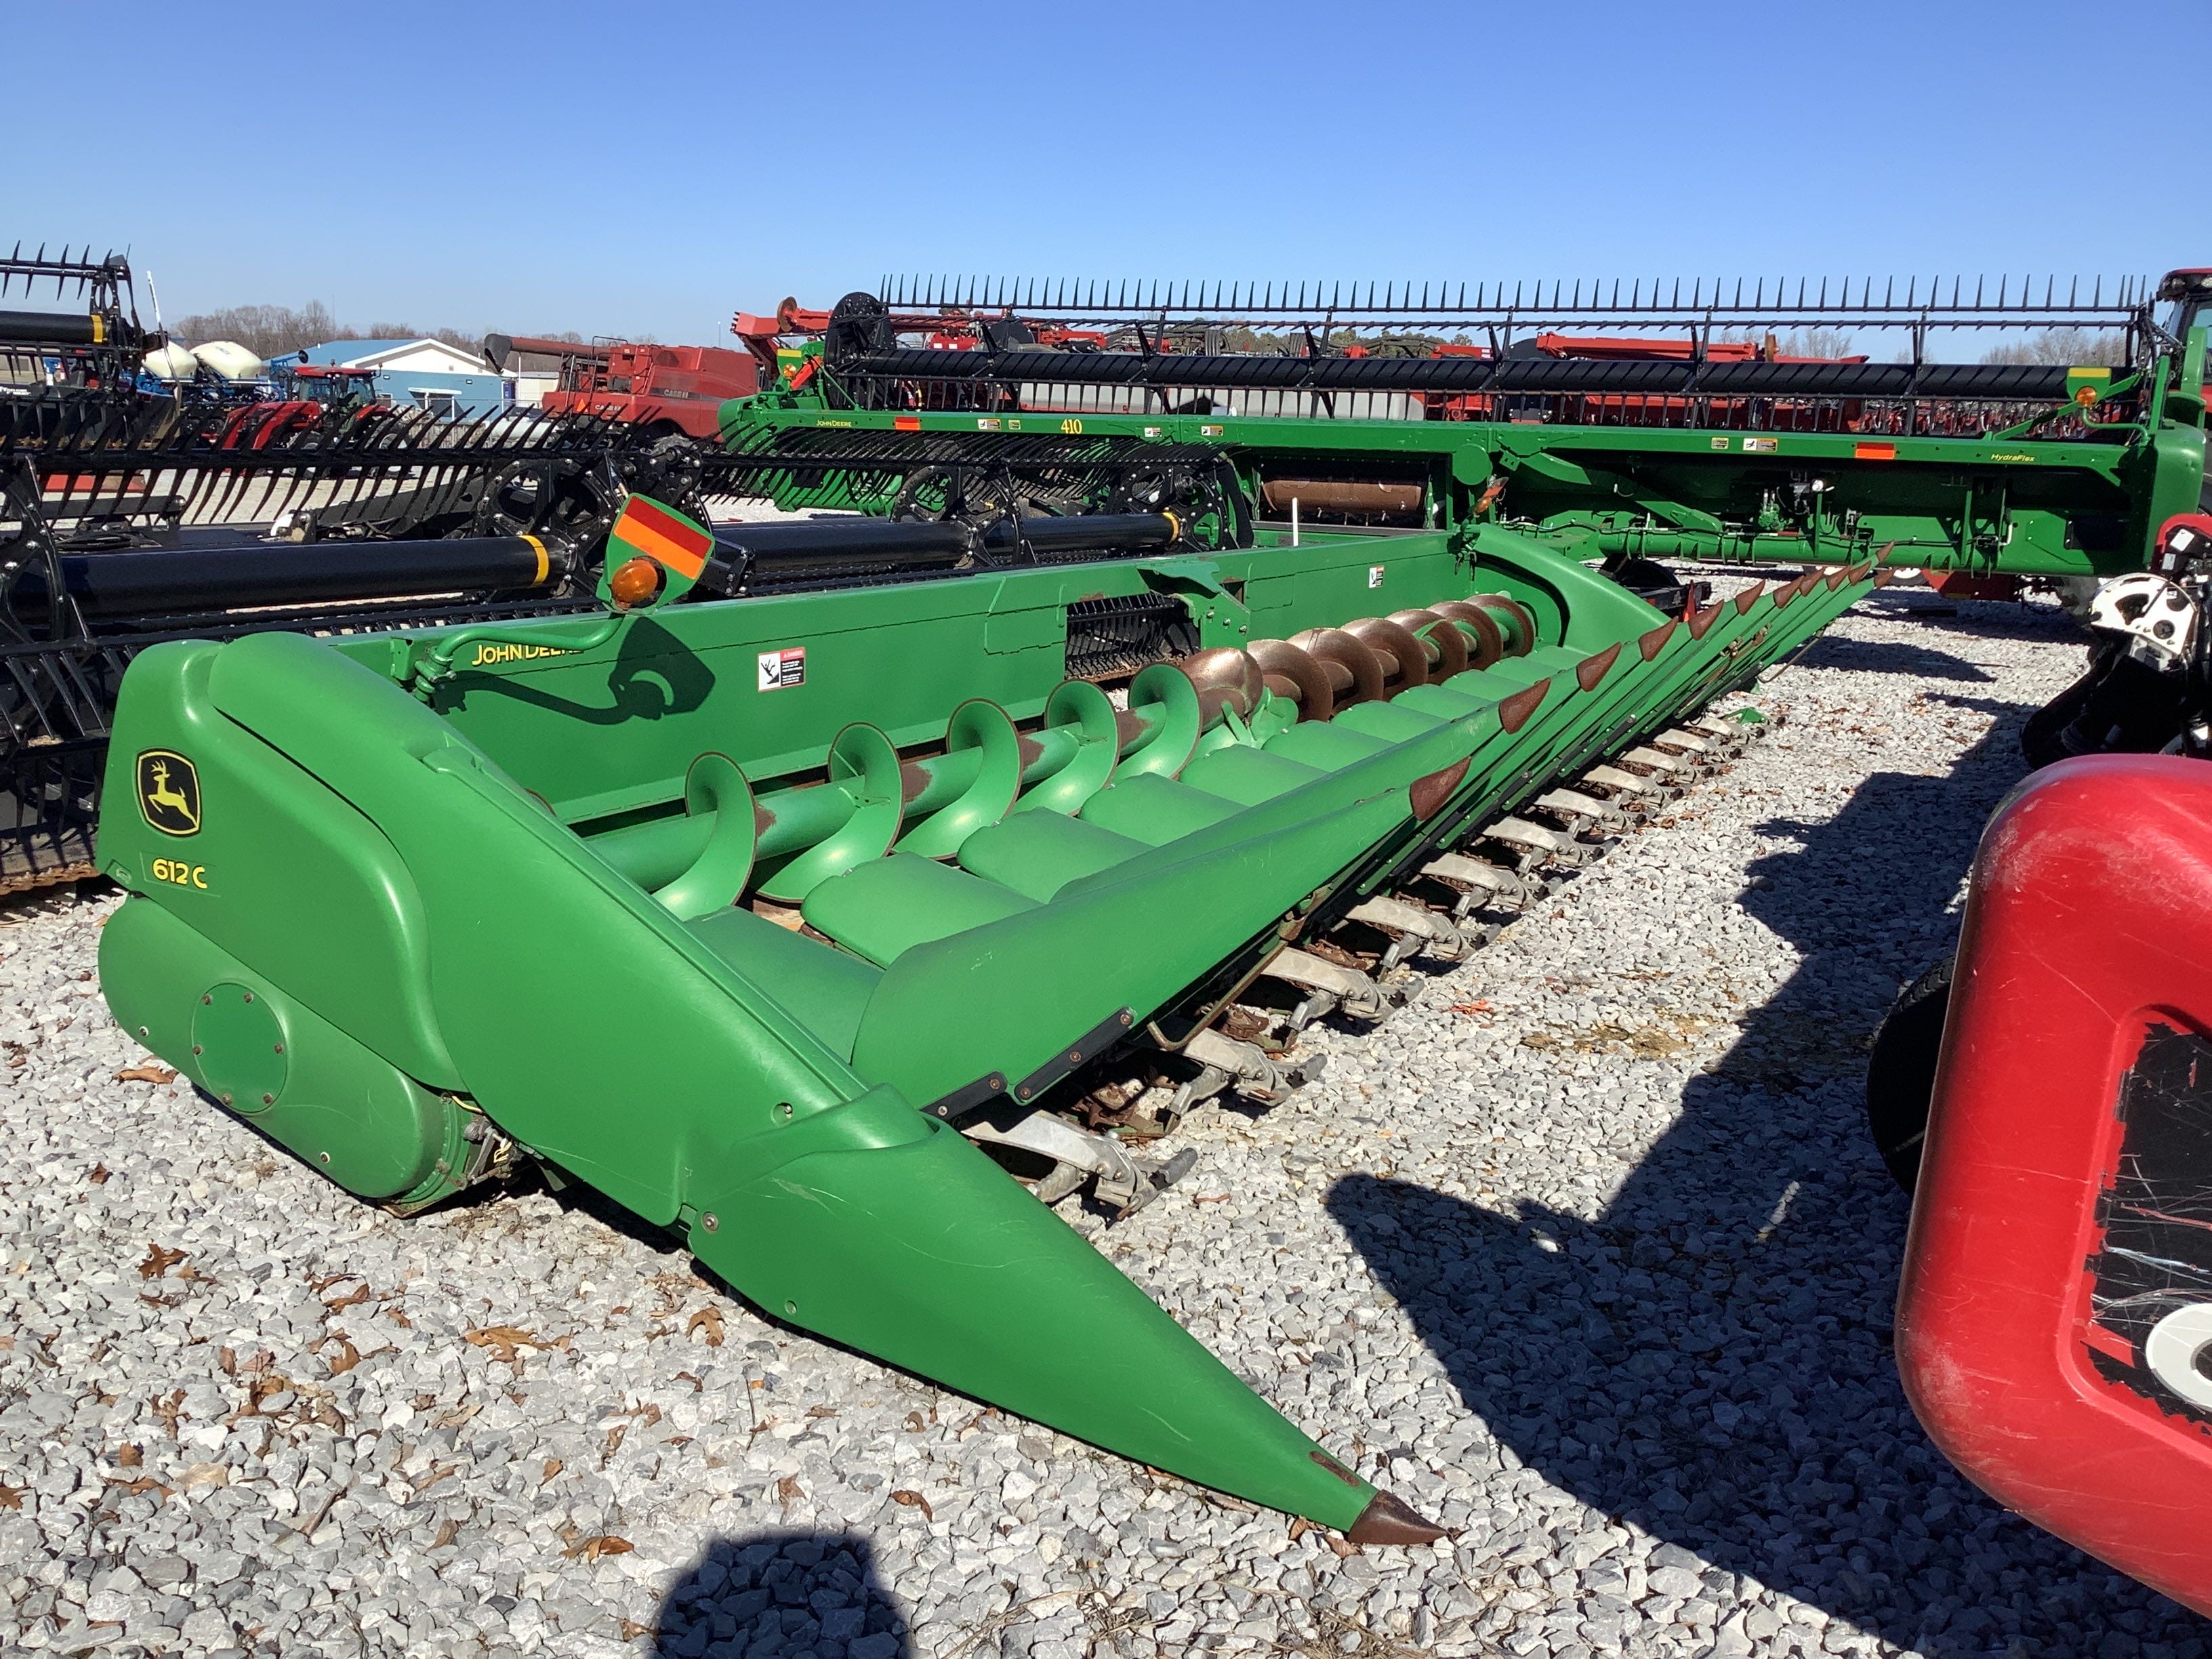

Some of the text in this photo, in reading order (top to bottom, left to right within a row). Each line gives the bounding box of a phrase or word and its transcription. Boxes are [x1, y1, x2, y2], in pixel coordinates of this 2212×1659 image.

[1061, 419, 1083, 434] 410
[1991, 453, 2036, 462] HydraFlex
[472, 644, 523, 665] JOHN
